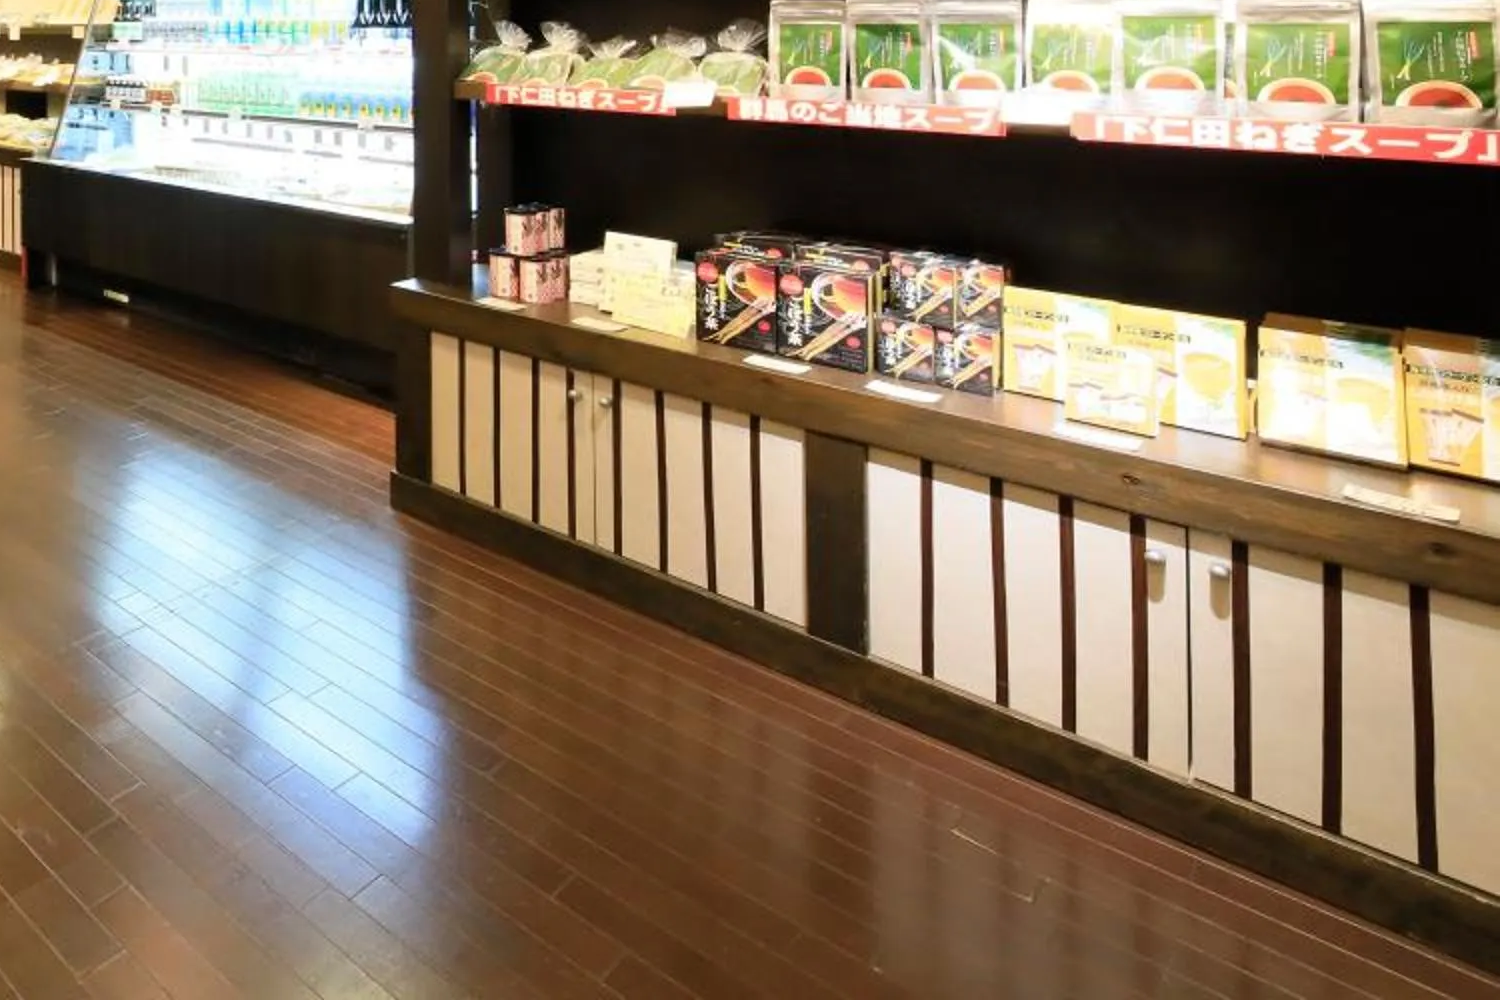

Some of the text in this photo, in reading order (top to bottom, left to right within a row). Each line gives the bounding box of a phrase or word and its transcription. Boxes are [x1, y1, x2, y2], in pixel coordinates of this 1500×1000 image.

[1095, 113, 1498, 163] 「下仁田ねぎスープ」
